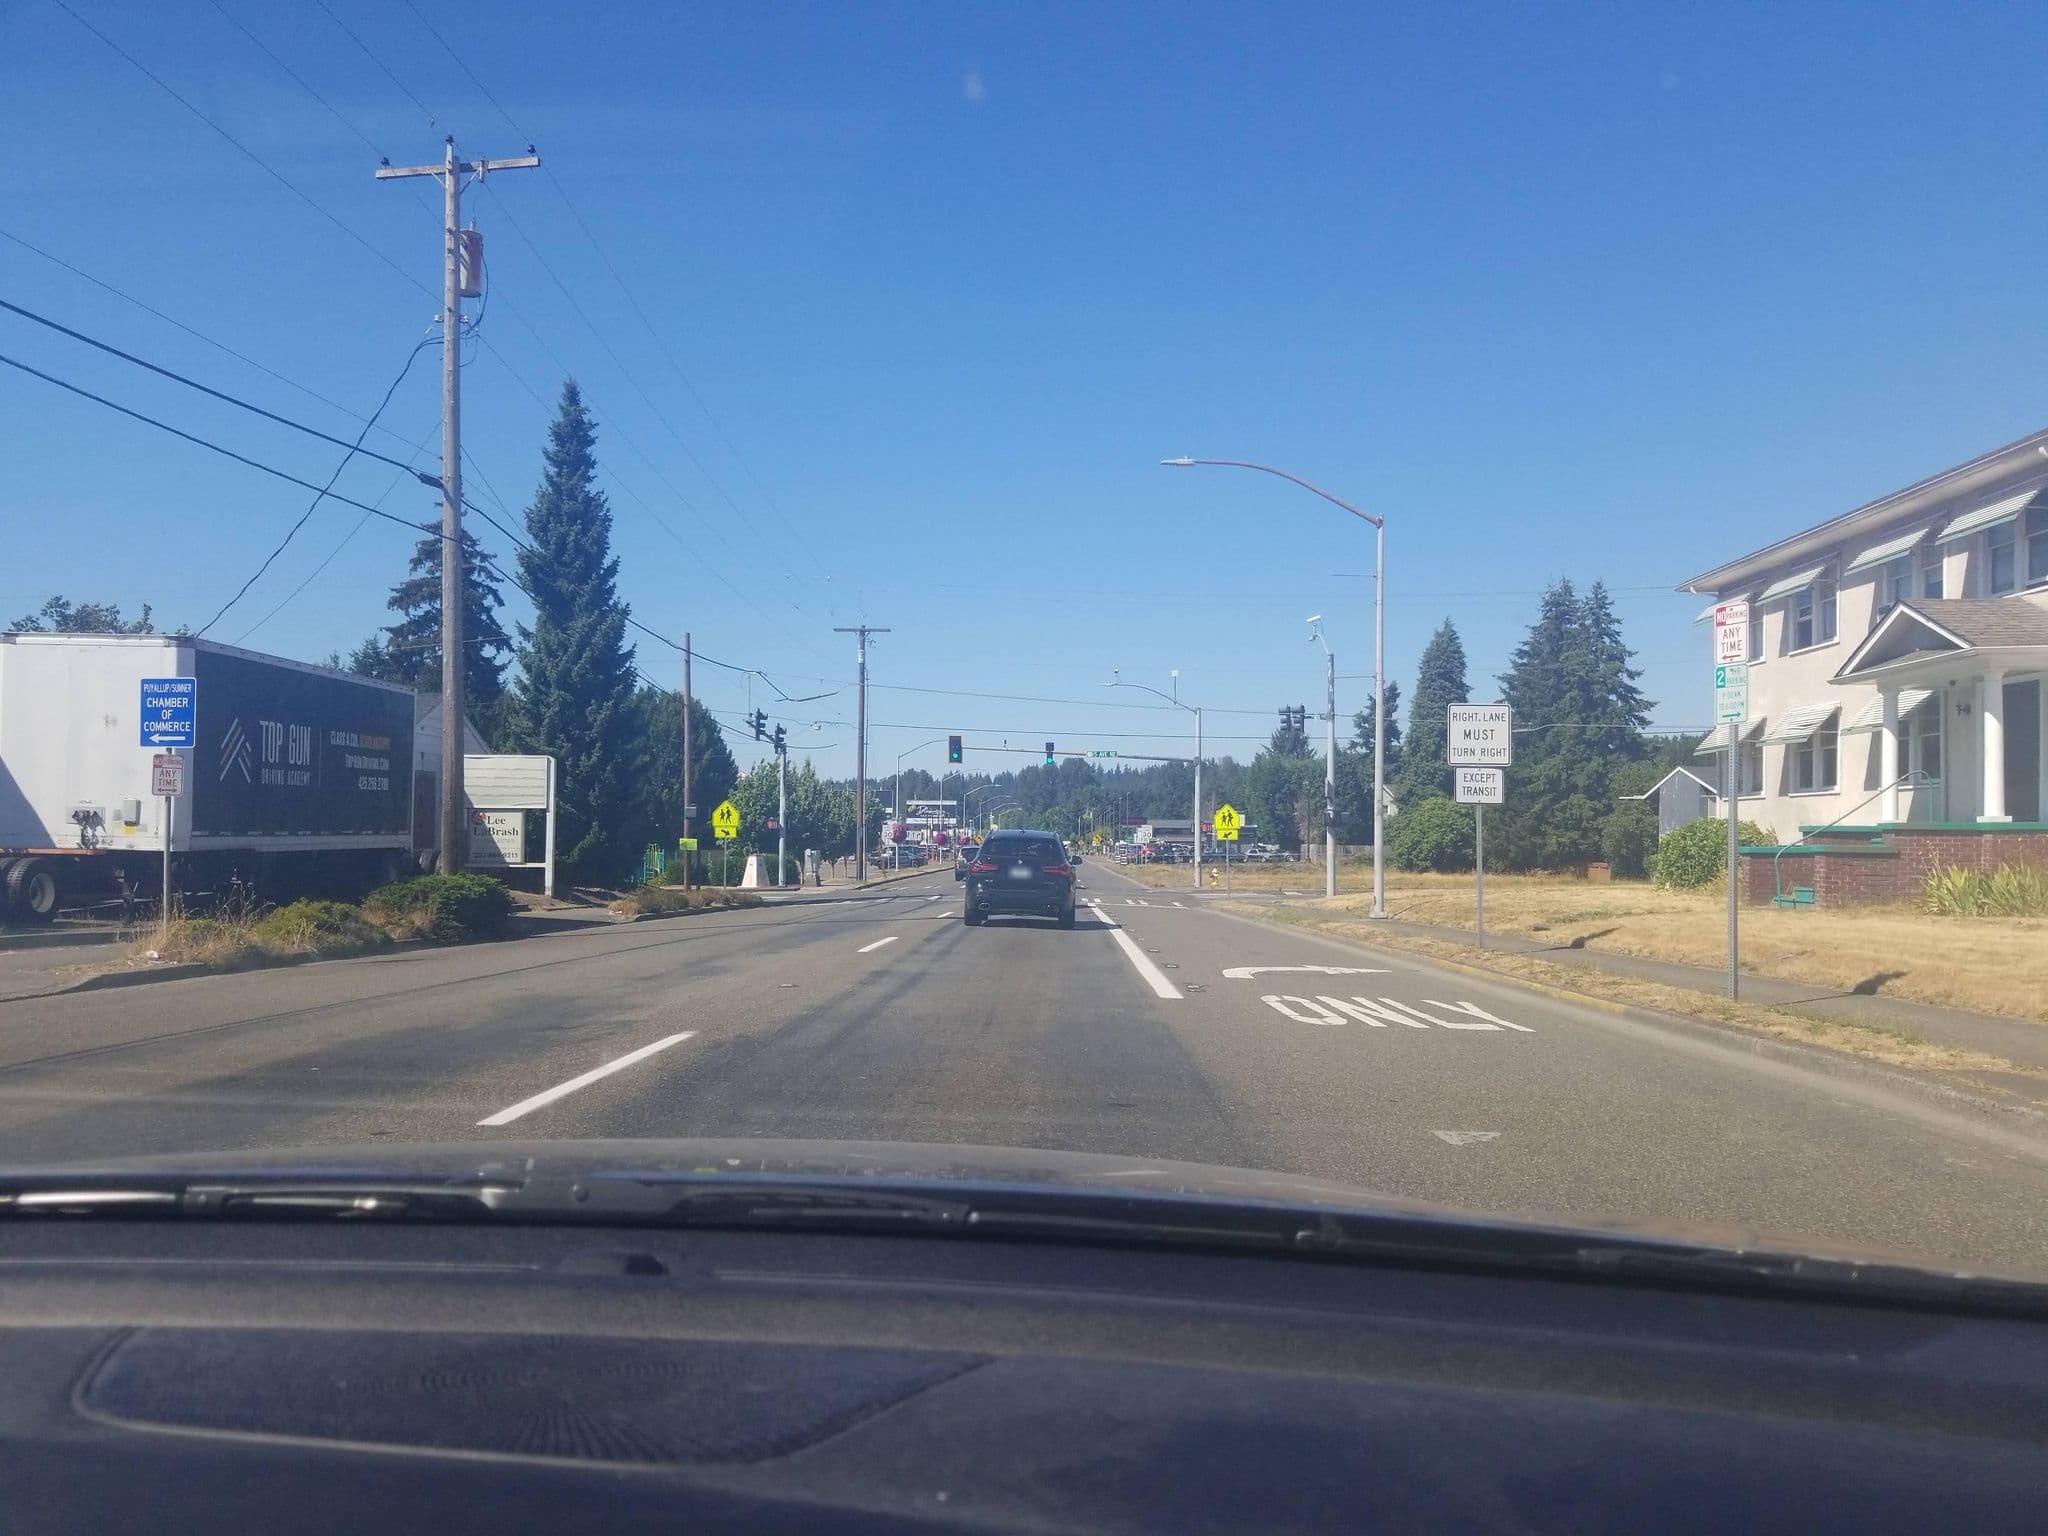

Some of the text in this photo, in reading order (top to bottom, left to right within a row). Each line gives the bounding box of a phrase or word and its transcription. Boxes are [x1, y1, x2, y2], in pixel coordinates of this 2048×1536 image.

[1723, 627, 1741, 639] ANY
[1721, 640, 1743, 653] TIME
[1717, 671, 1725, 686] 2
[143, 683, 192, 693] PUYALLUP/SUMNER
[146, 697, 189, 708] CHAMBER
[161, 709, 173, 720] OF
[1452, 712, 1507, 722] RIGHT LANE
[143, 721, 191, 732] COMMERCE
[1463, 729, 1495, 741] MUST
[260, 720, 311, 766] TOP GUN
[1452, 747, 1507, 758] TURN RIGHT
[159, 769, 177, 777] ANY
[1463, 773, 1496, 783] EXCEPT
[158, 778, 178, 787] TIME
[1462, 786, 1497, 797] TRANSIT
[487, 815, 506, 825] Lee
[473, 827, 519, 836] LaBrash
[1261, 995, 1536, 1033] ONLY
